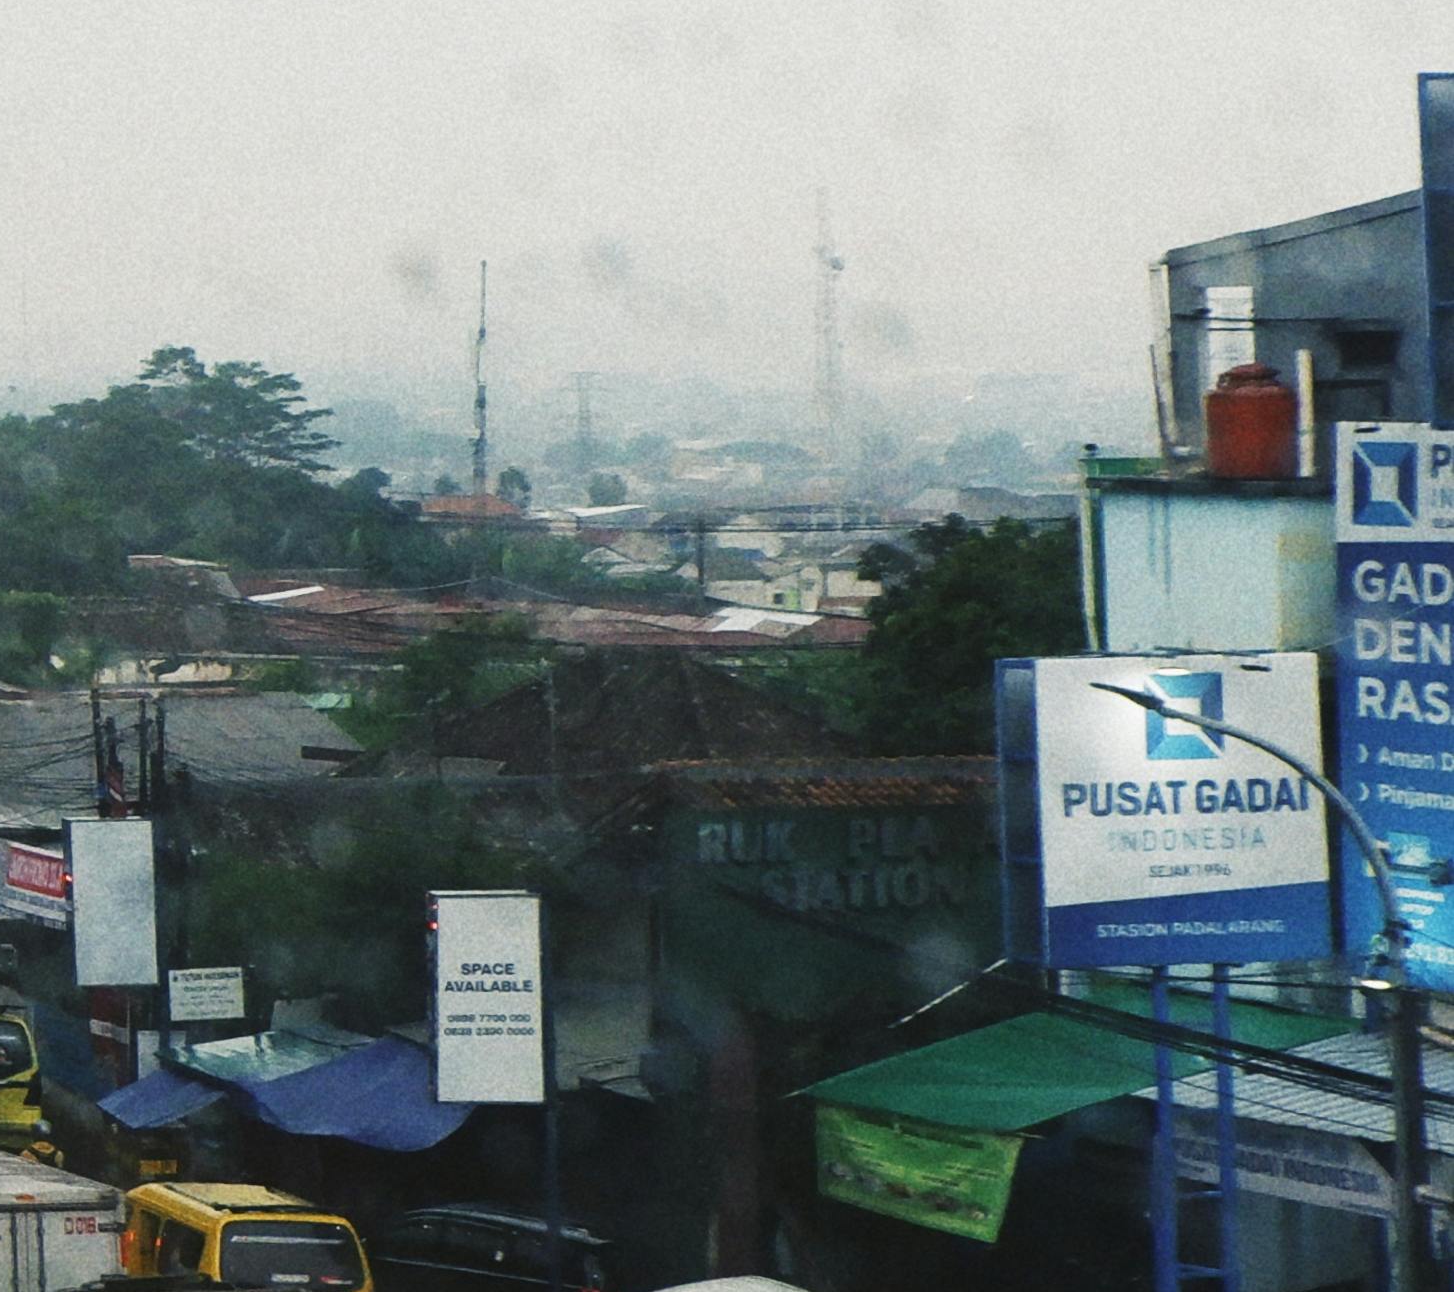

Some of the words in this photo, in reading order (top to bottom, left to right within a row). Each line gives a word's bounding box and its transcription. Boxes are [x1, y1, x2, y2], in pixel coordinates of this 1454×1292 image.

[1356, 675, 1454, 725] RAS
[1062, 780, 1187, 817] PUSAT
[1194, 777, 1310, 814] GADAI
[1108, 827, 1267, 852] INDONESIA
[1096, 924, 1169, 938] STASION
[461, 962, 516, 976] SPACE
[444, 979, 534, 993] AVAILABLE
